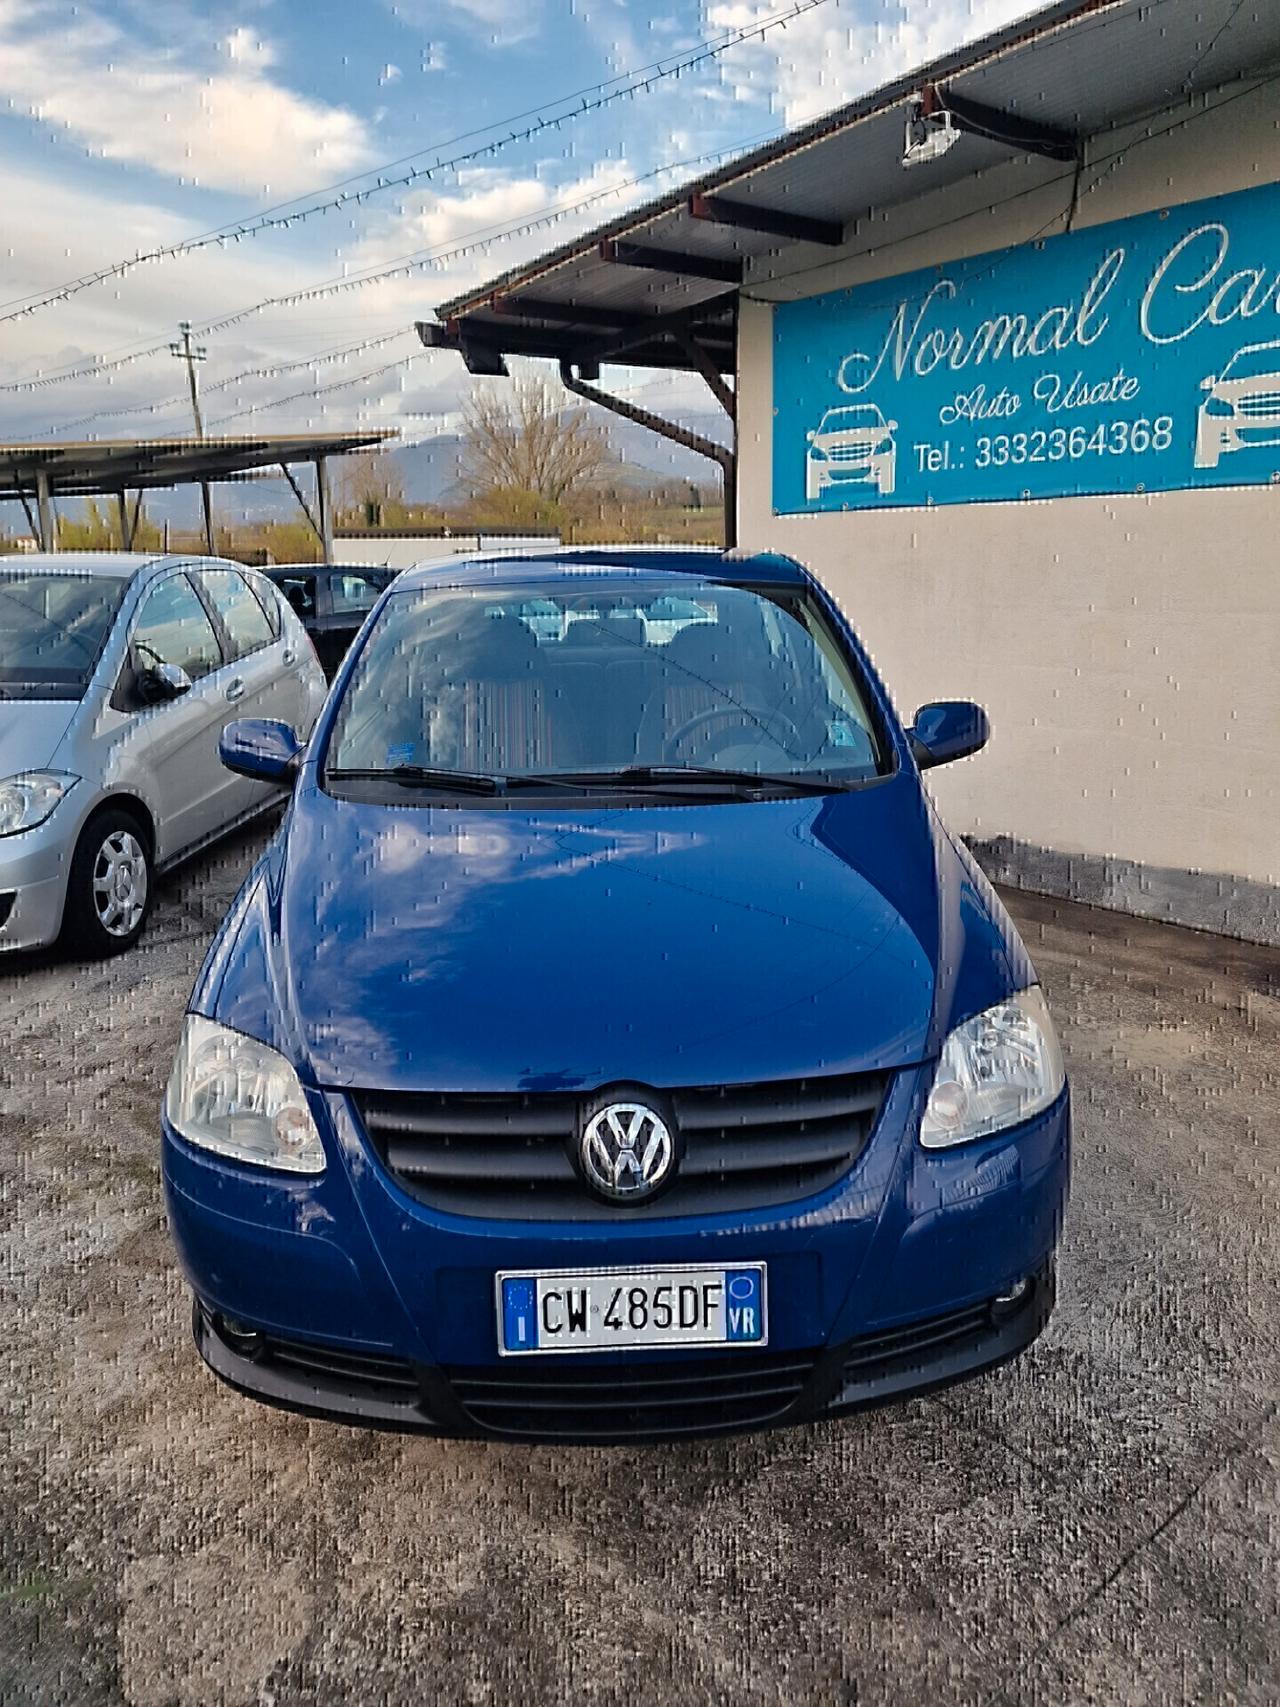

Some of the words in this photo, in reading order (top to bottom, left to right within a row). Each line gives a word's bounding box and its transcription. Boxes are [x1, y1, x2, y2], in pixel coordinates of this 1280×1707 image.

[837, 247, 1126, 393] Normal
[939, 383, 1022, 424] Auto
[1033, 368, 1141, 413] Usate
[914, 441, 965, 472] Tel.:
[975, 416, 1173, 467] 3332364368
[729, 1307, 755, 1334] VR
